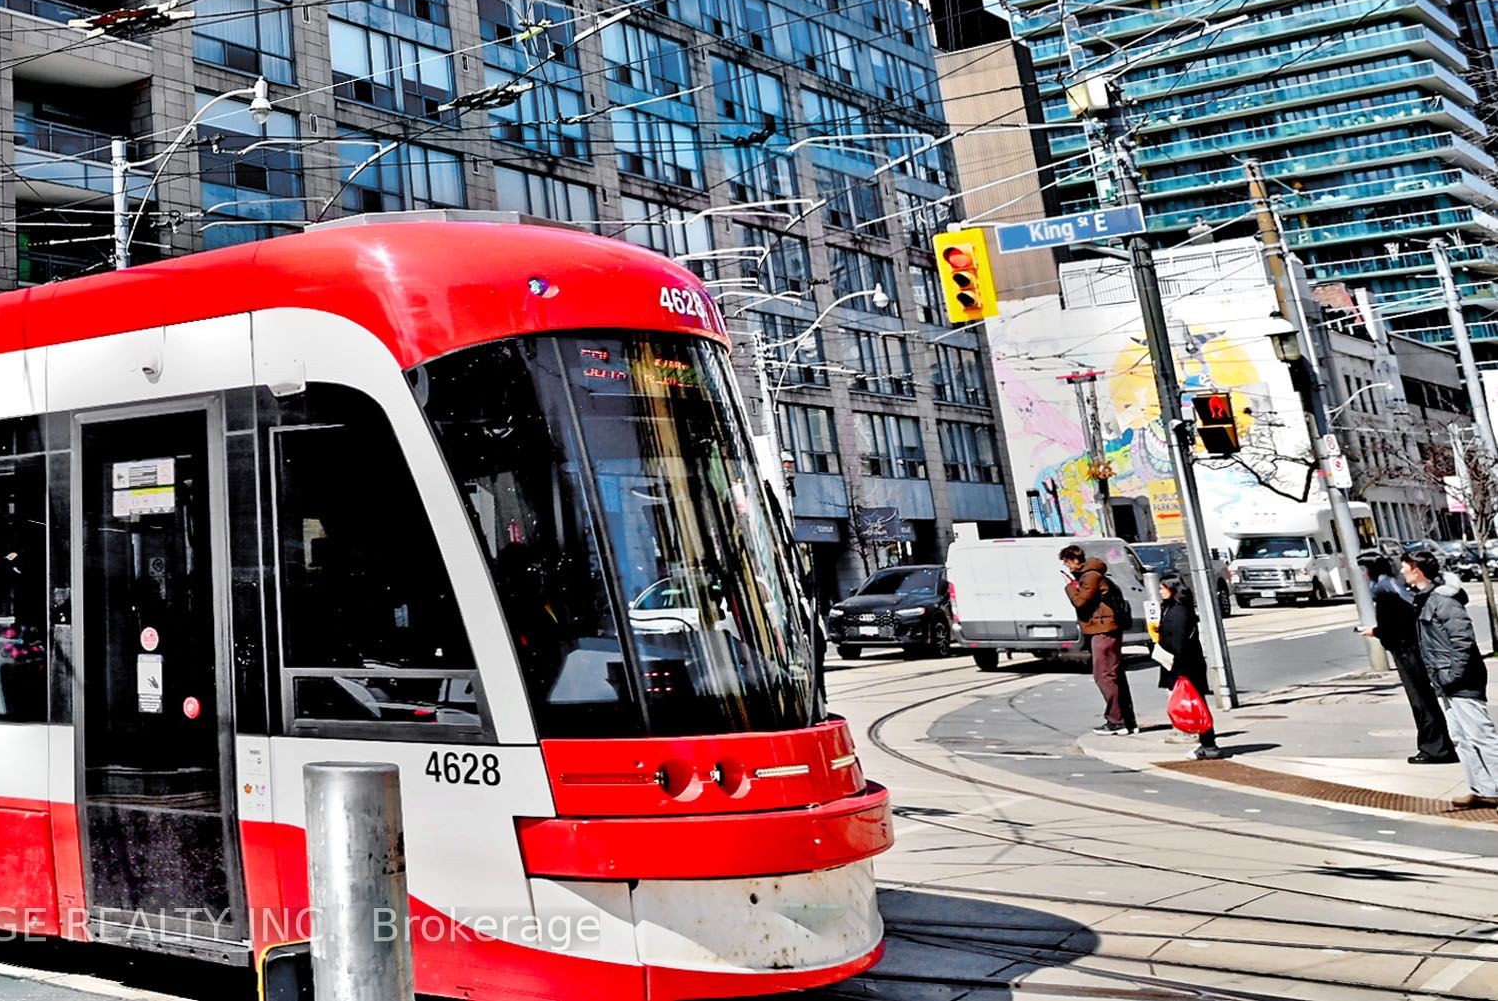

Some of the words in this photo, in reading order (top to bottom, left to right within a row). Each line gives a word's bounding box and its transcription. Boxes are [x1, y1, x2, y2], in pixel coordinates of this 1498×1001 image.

[1029, 221, 1075, 241] King
[1077, 217, 1089, 227] St
[1094, 213, 1108, 232] E
[660, 286, 705, 319] 4628
[425, 751, 501, 786] 4628
